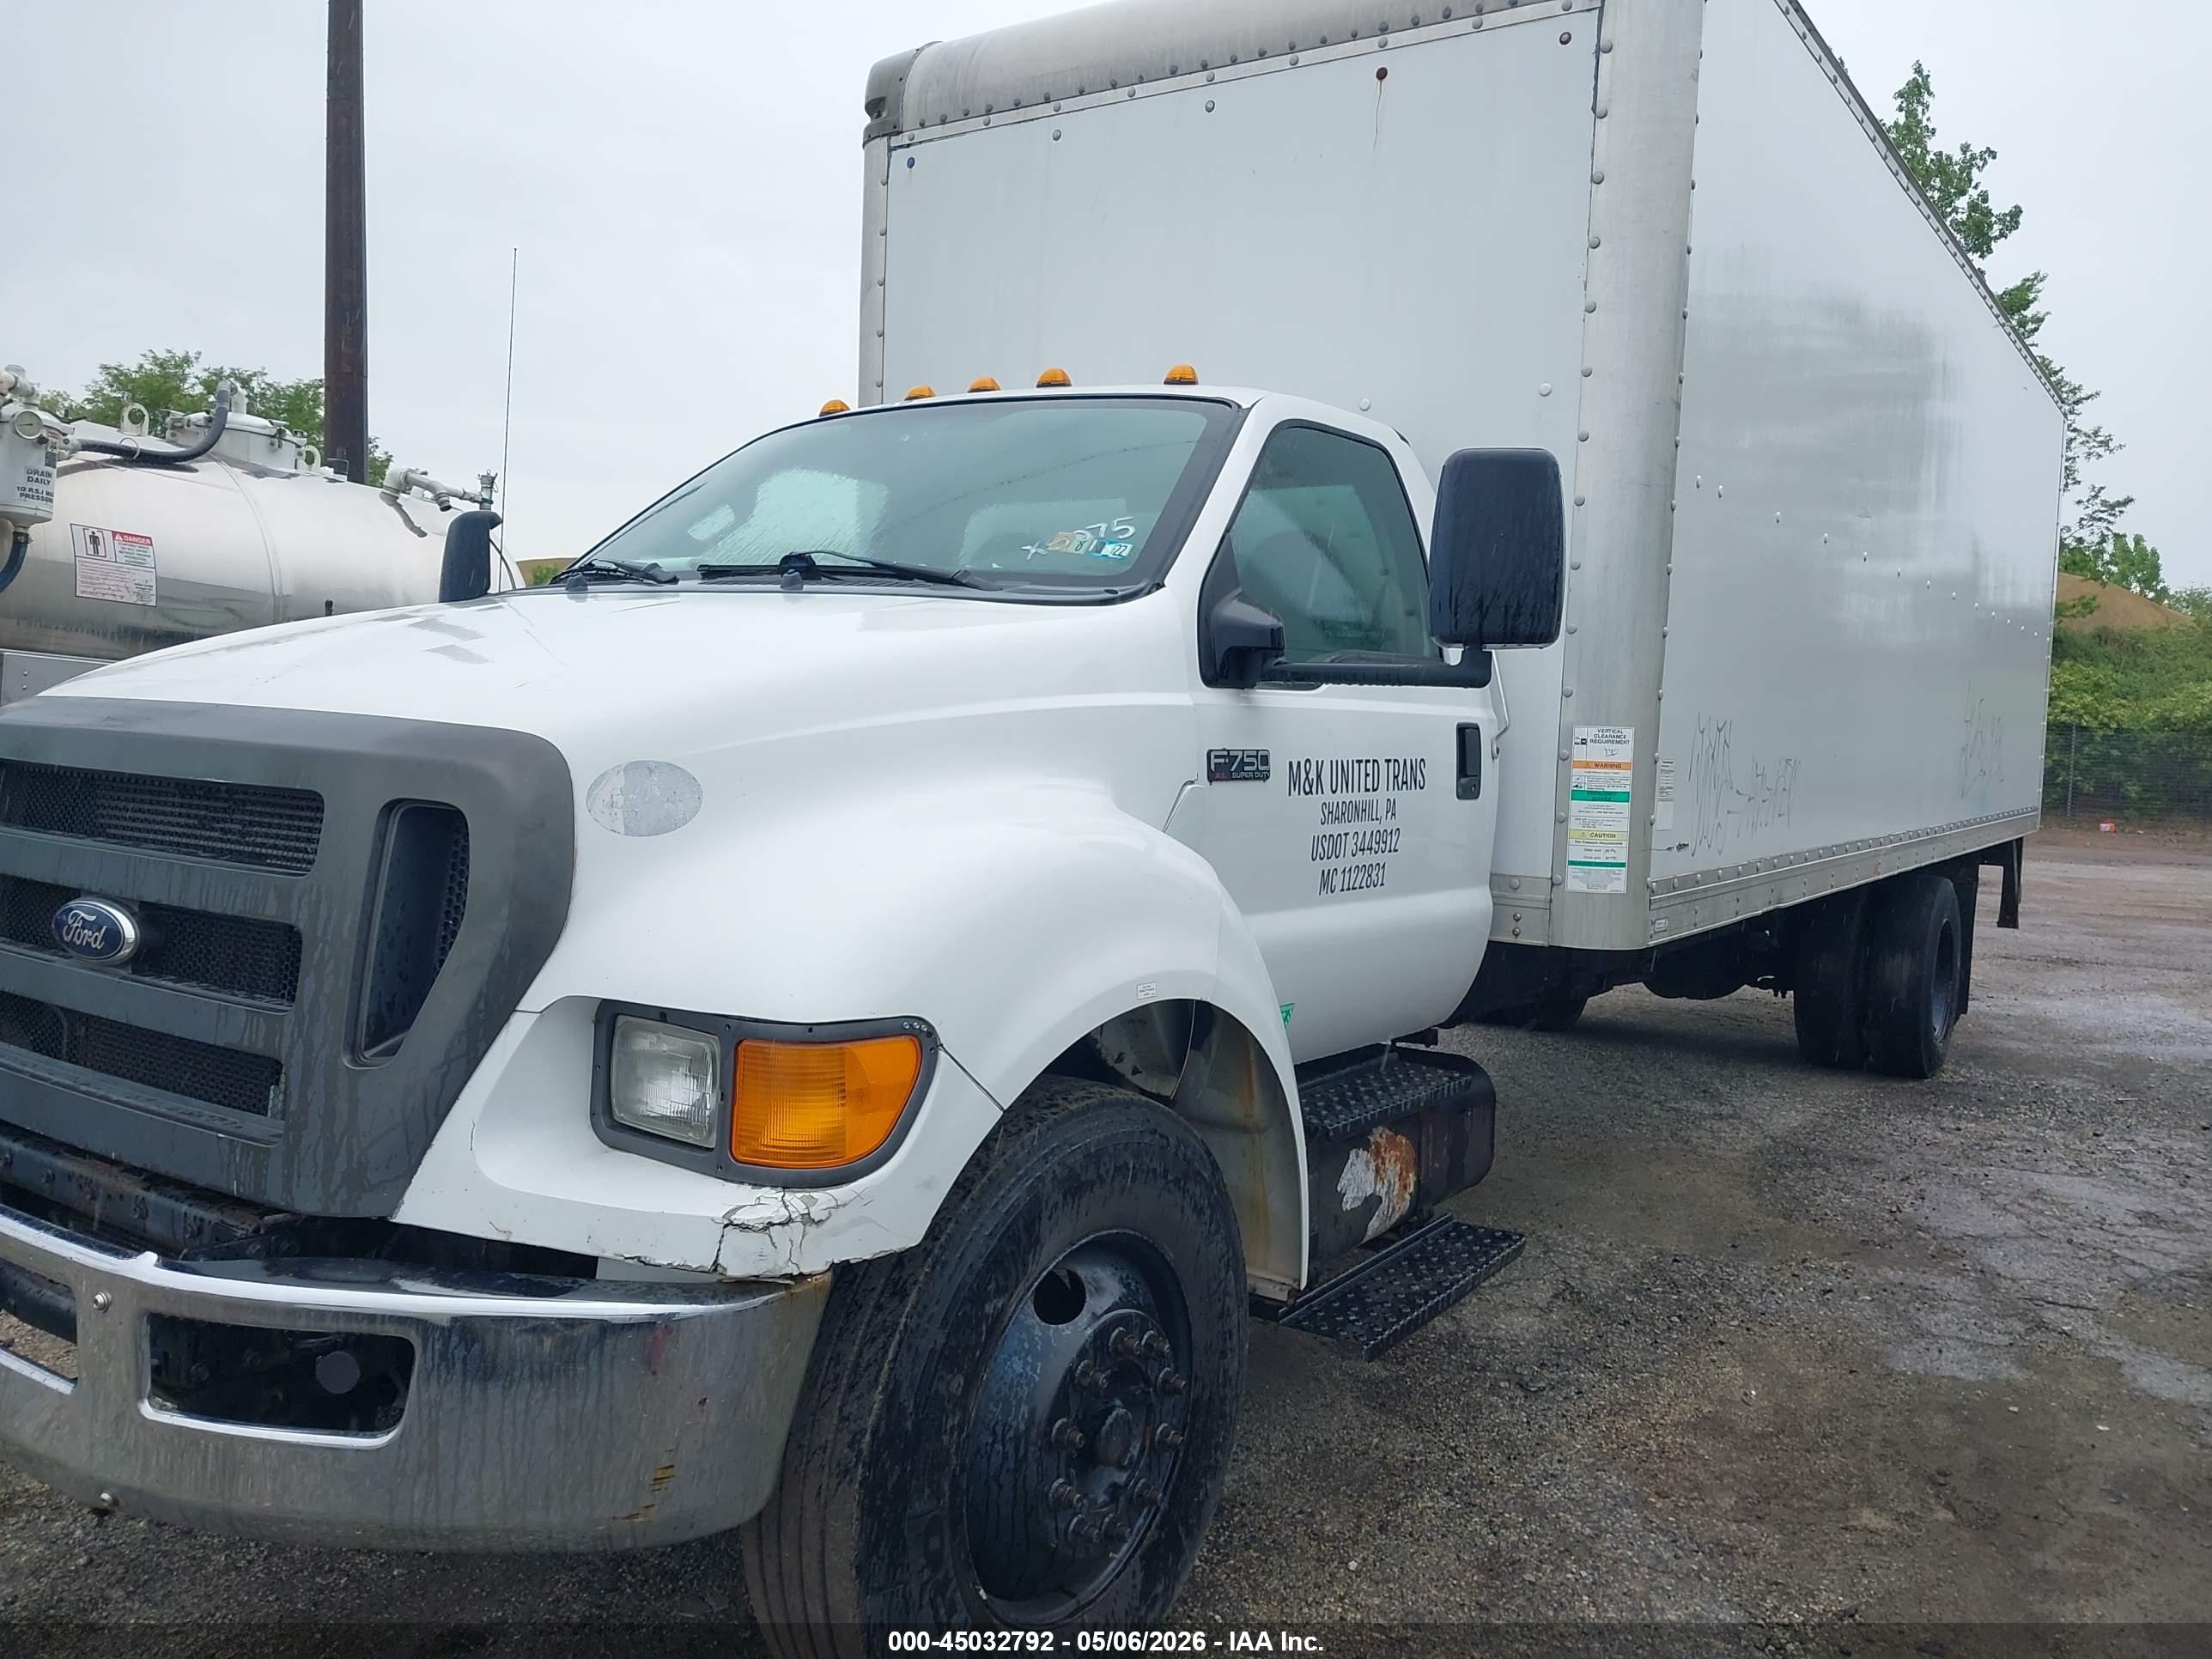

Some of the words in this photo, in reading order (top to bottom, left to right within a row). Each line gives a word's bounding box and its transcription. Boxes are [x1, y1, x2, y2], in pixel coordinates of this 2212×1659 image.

[27, 468, 52, 479] DRAIN
[27, 476, 52, 486] DAILY
[124, 535, 151, 545] DANGER
[1288, 758, 1325, 797] M&K
[1330, 758, 1380, 795] UNITED
[1384, 757, 1426, 792] TRANS
[1320, 799, 1382, 825] SHARONHILL,
[1385, 798, 1397, 821] PA
[1310, 832, 1350, 862] USDOT
[1351, 827, 1401, 858] 3449912
[1318, 867, 1338, 896] MC
[1339, 861, 1387, 893] 1122831
[62, 909, 108, 950] Ford
